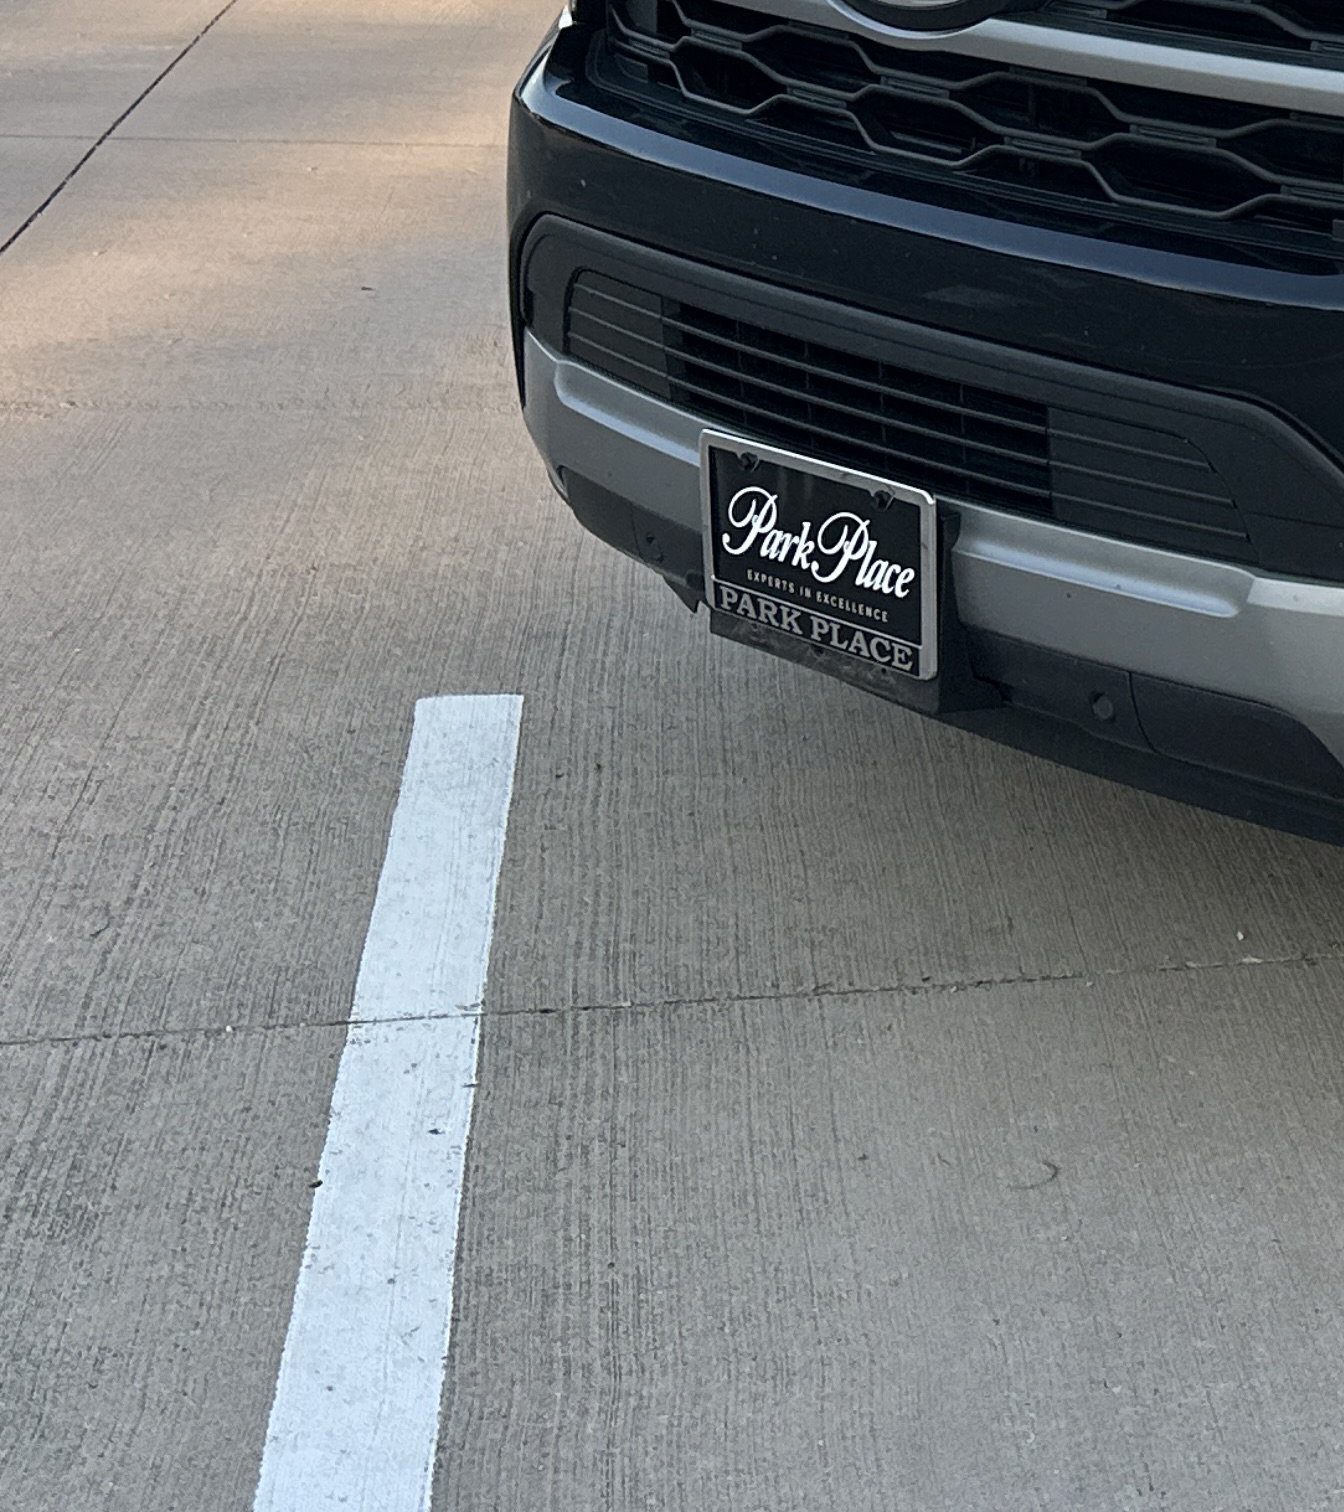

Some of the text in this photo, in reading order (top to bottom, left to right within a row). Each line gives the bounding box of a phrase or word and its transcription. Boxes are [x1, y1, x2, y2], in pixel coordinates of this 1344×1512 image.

[722, 486, 915, 598] Park Place
[719, 585, 914, 671] PARK PLACE
[747, 569, 889, 622] EXPERTS IN EXCELLENCE
